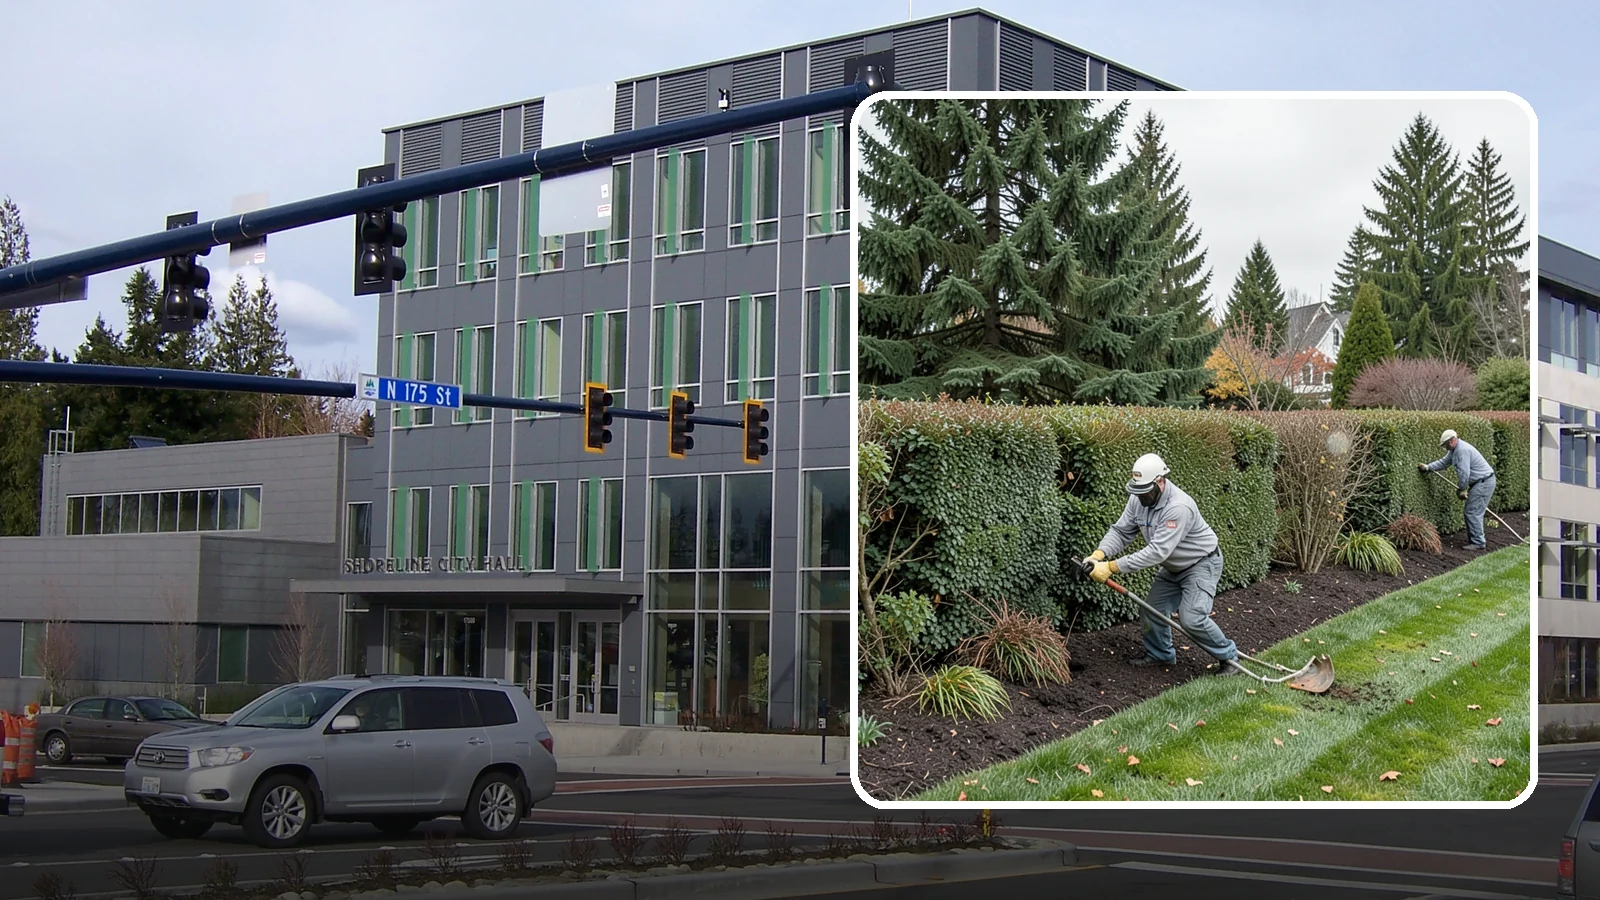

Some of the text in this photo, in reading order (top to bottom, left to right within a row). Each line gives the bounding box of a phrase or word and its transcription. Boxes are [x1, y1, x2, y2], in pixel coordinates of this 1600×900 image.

[387, 380, 451, 406] N 175 St
[344, 556, 525, 573] SHORELINE CITY HALL
